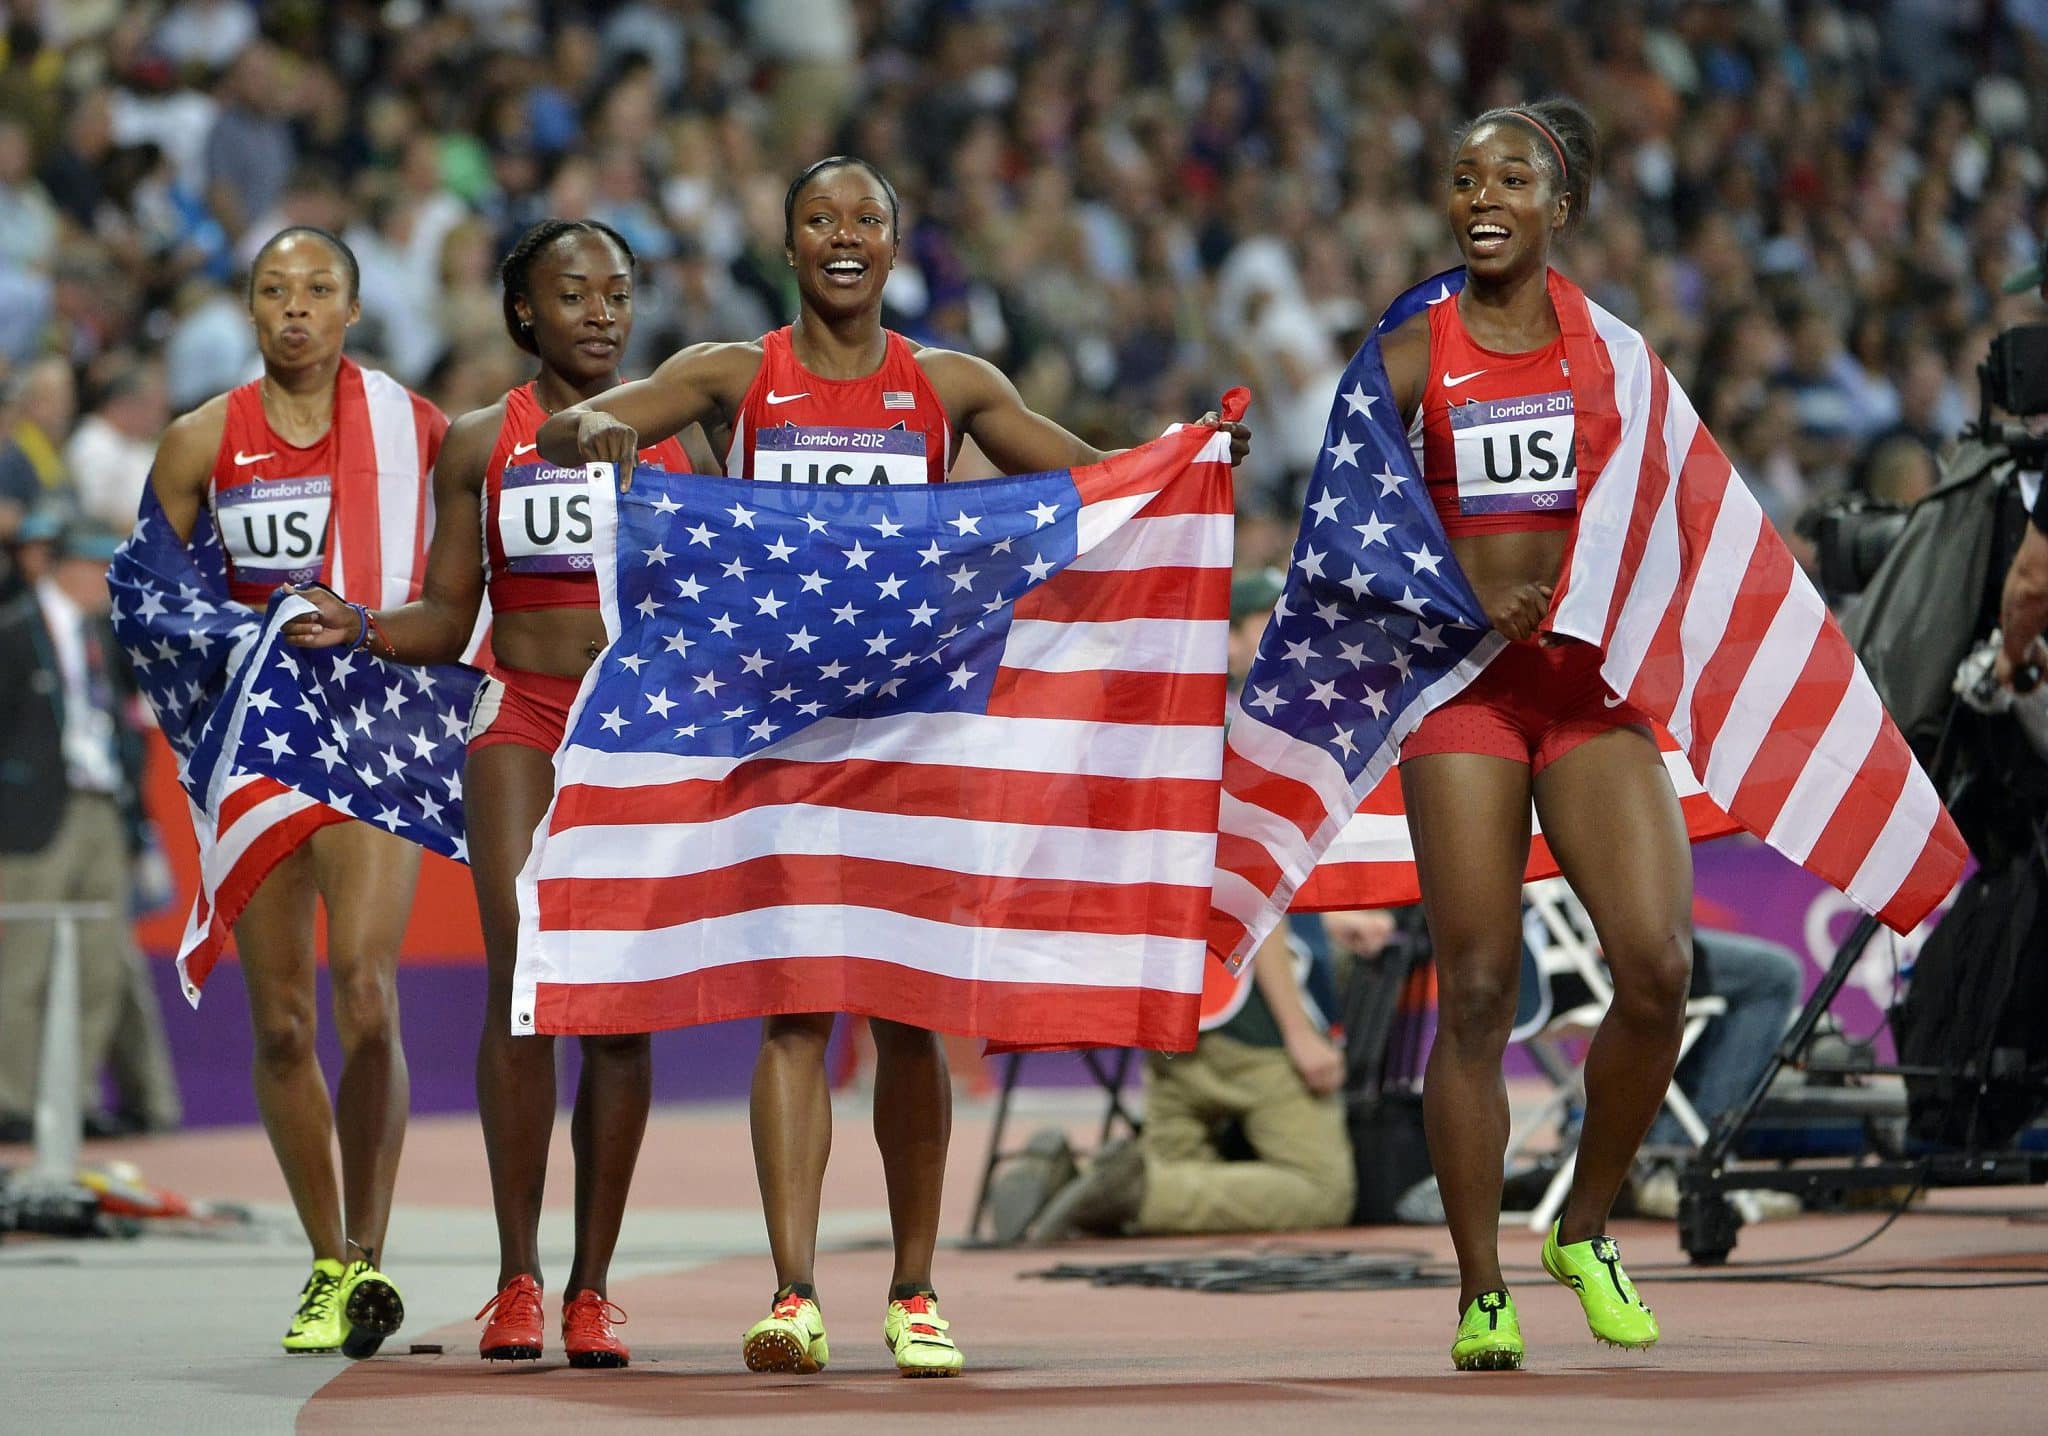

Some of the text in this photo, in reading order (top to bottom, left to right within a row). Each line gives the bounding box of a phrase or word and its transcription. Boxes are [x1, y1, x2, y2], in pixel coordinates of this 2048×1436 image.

[1490, 400, 1543, 418] London
[794, 431, 885, 448] London 2012
[535, 467, 587, 481] London
[250, 483, 301, 499] London
